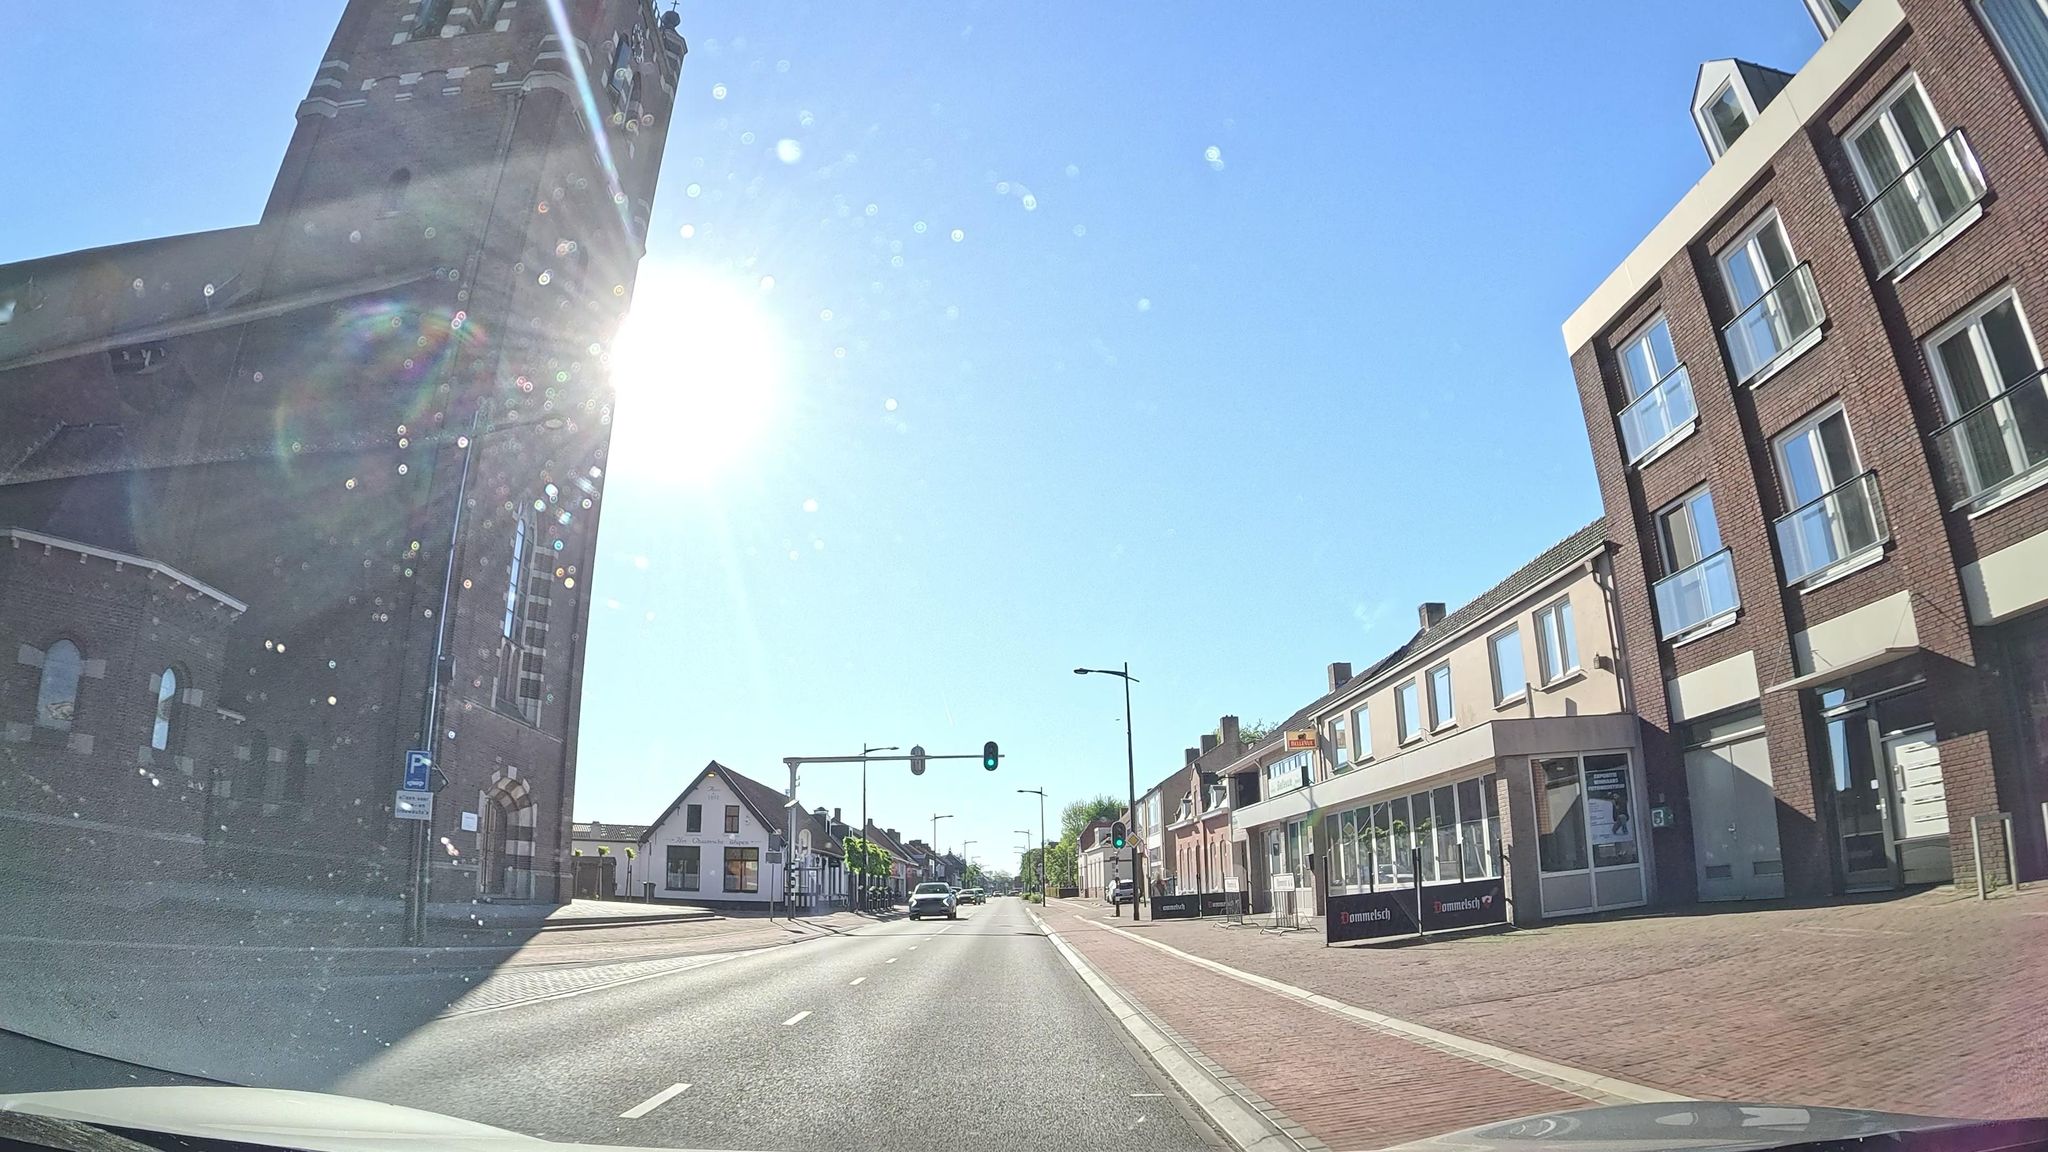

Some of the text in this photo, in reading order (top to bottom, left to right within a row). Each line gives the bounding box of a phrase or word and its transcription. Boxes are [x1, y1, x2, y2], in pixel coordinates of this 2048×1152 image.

[410, 754, 424, 774] P
[1433, 897, 1480, 913] Dommelsch
[1340, 907, 1391, 925] Dommelsch
